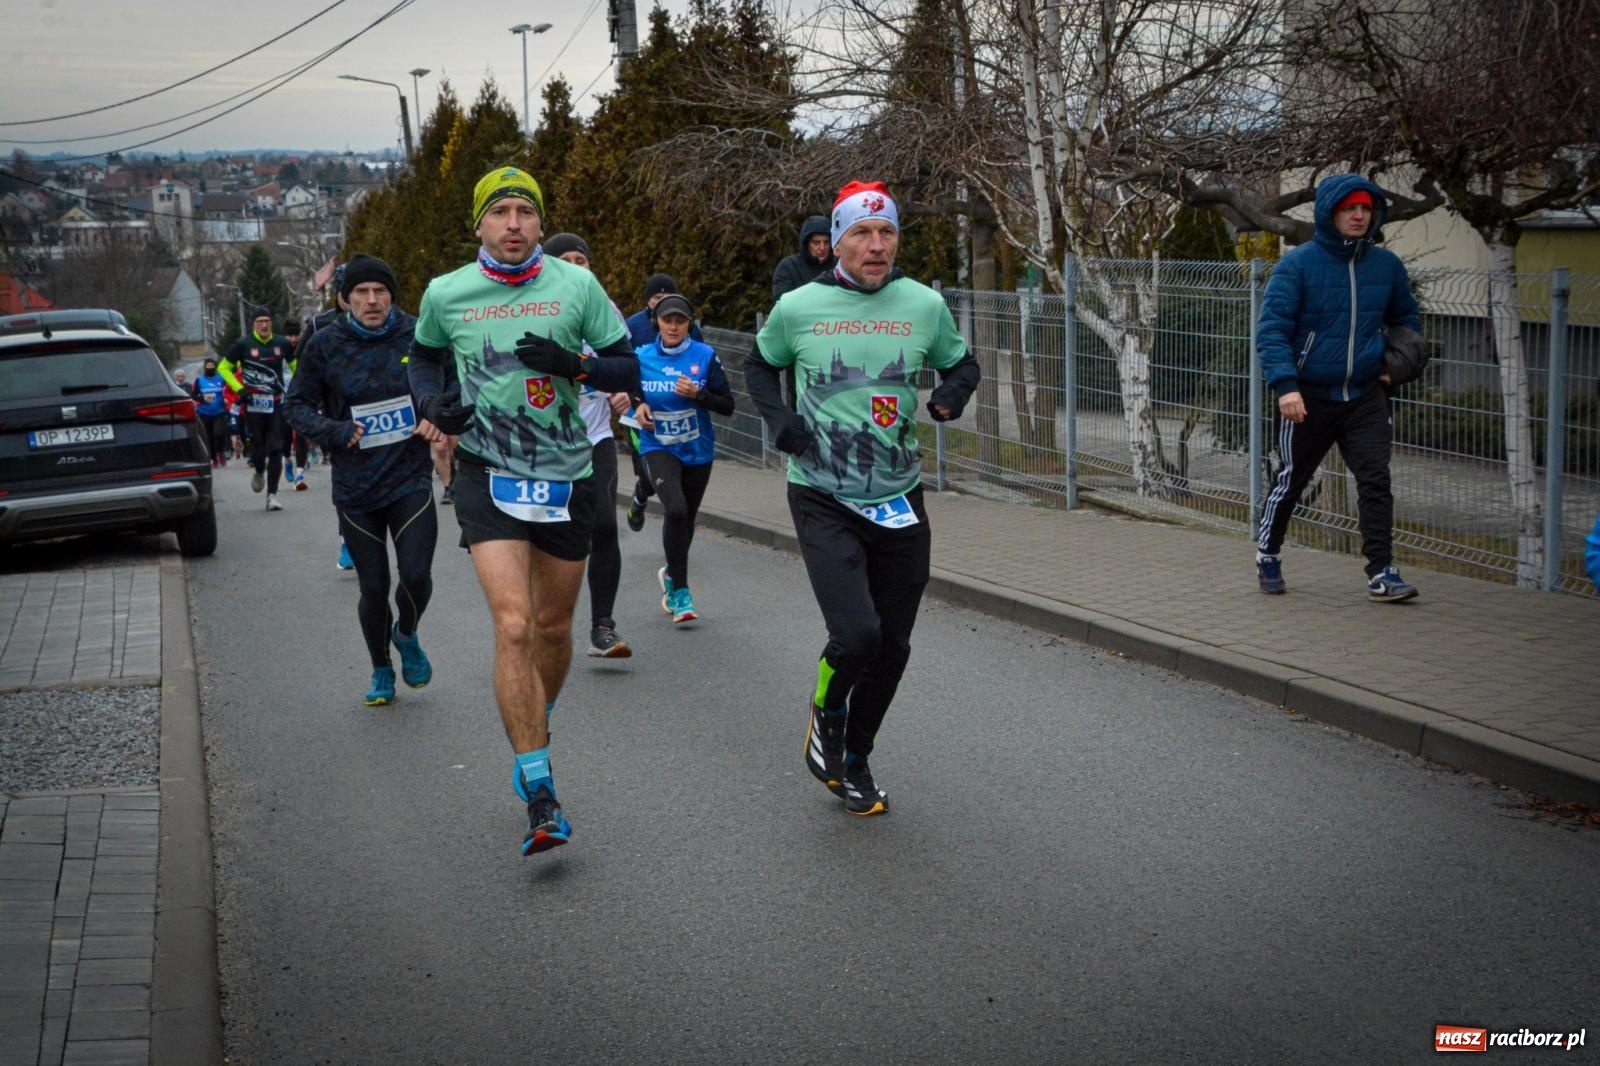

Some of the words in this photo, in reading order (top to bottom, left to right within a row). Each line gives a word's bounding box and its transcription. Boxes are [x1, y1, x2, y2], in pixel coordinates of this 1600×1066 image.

[462, 300, 561, 323] CURSORES
[812, 319, 913, 337] CURSORES
[365, 410, 407, 435] 201
[661, 418, 691, 435] 154
[38, 430, 58, 446] OP
[65, 426, 109, 443] 1239P
[515, 479, 550, 504] 18
